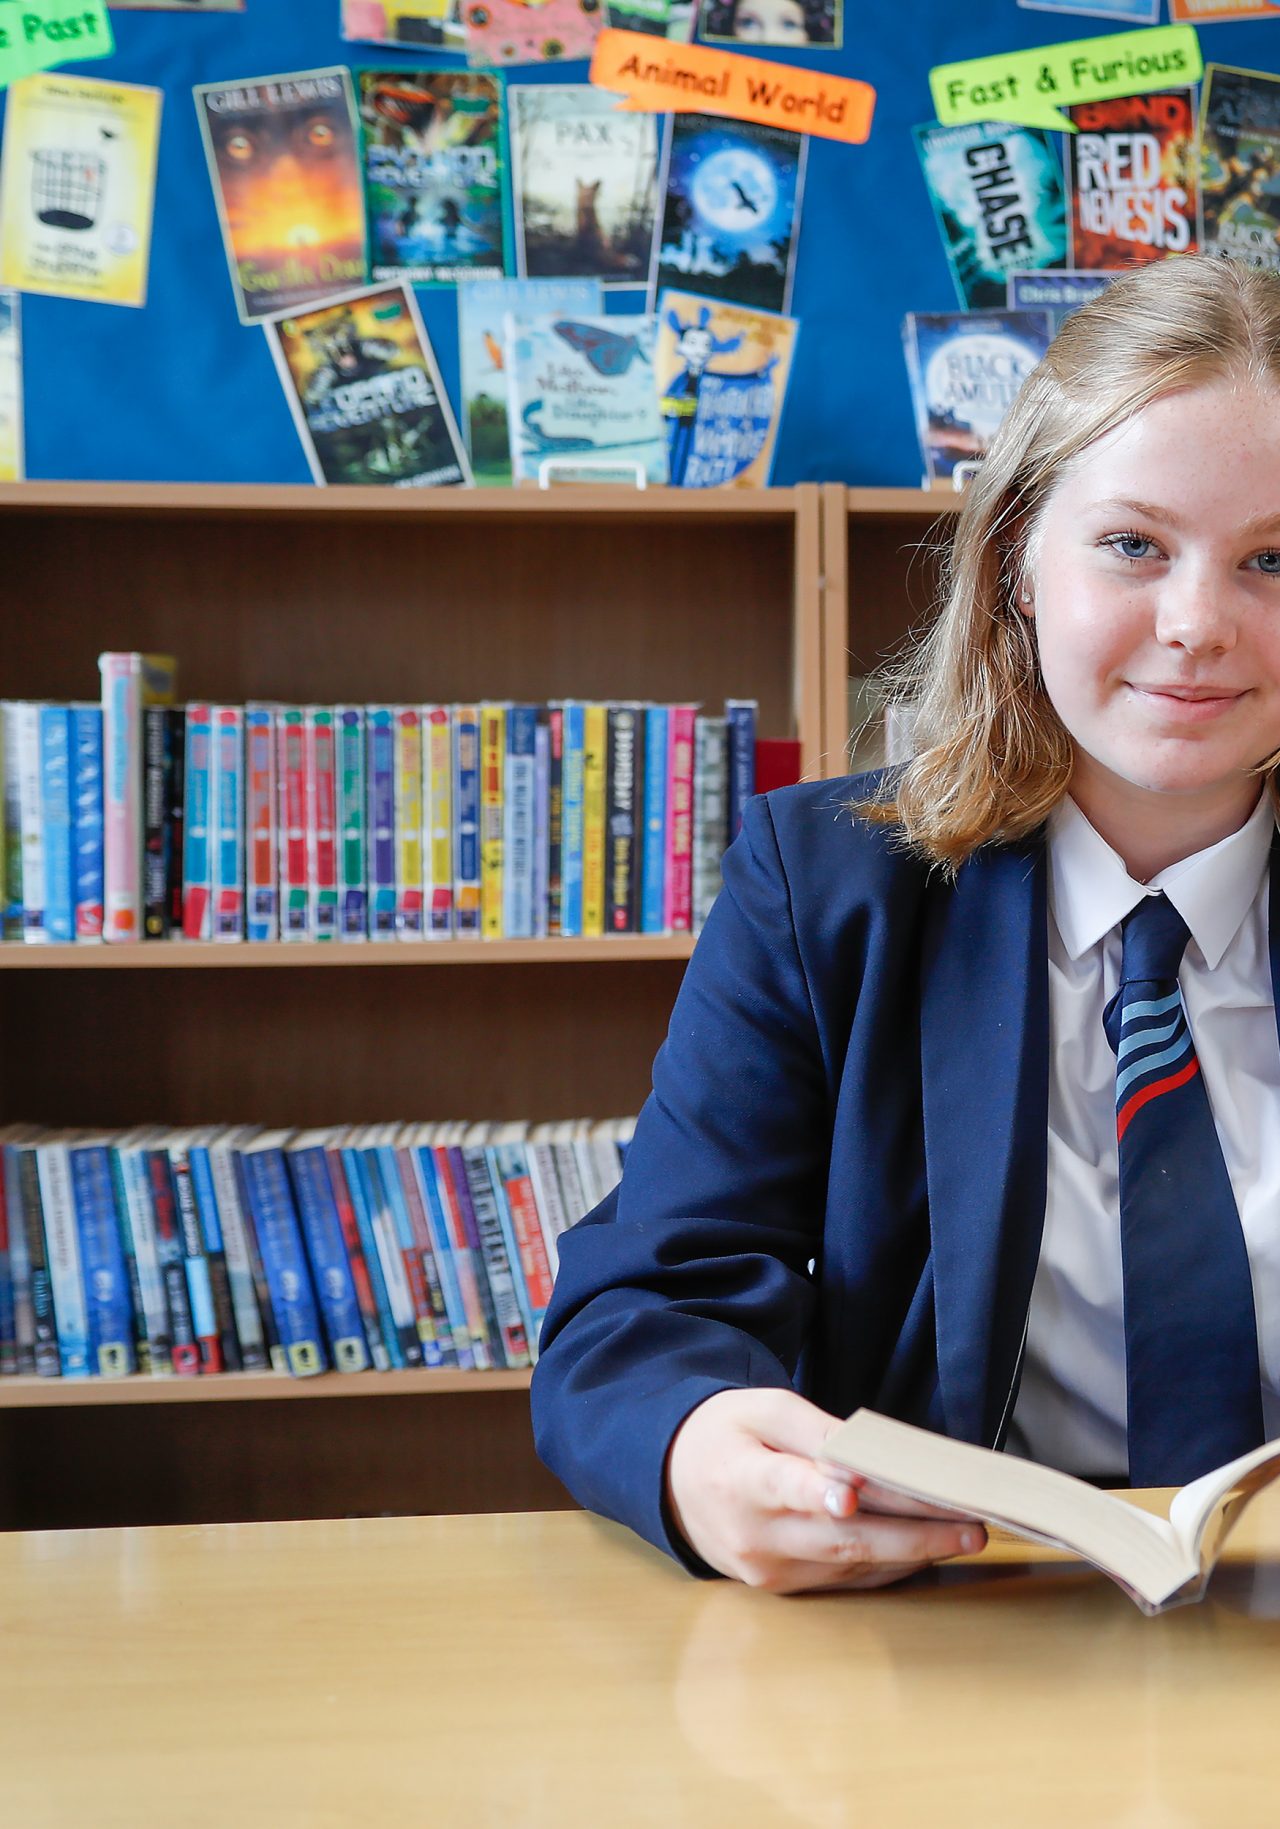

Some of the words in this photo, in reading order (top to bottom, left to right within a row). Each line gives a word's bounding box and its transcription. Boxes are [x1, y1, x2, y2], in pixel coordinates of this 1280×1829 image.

[23, 12, 98, 42] Past
[617, 54, 729, 98] Animal
[745, 77, 847, 124] World
[947, 74, 1020, 110] Fast
[1035, 65, 1058, 93] &
[1070, 48, 1187, 88] Furious
[555, 120, 614, 145] PAX
[1075, 132, 1162, 191] RED
[965, 142, 1034, 261] CHASE
[1078, 187, 1191, 252] NEMESIS
[943, 382, 1019, 406] AMULE
